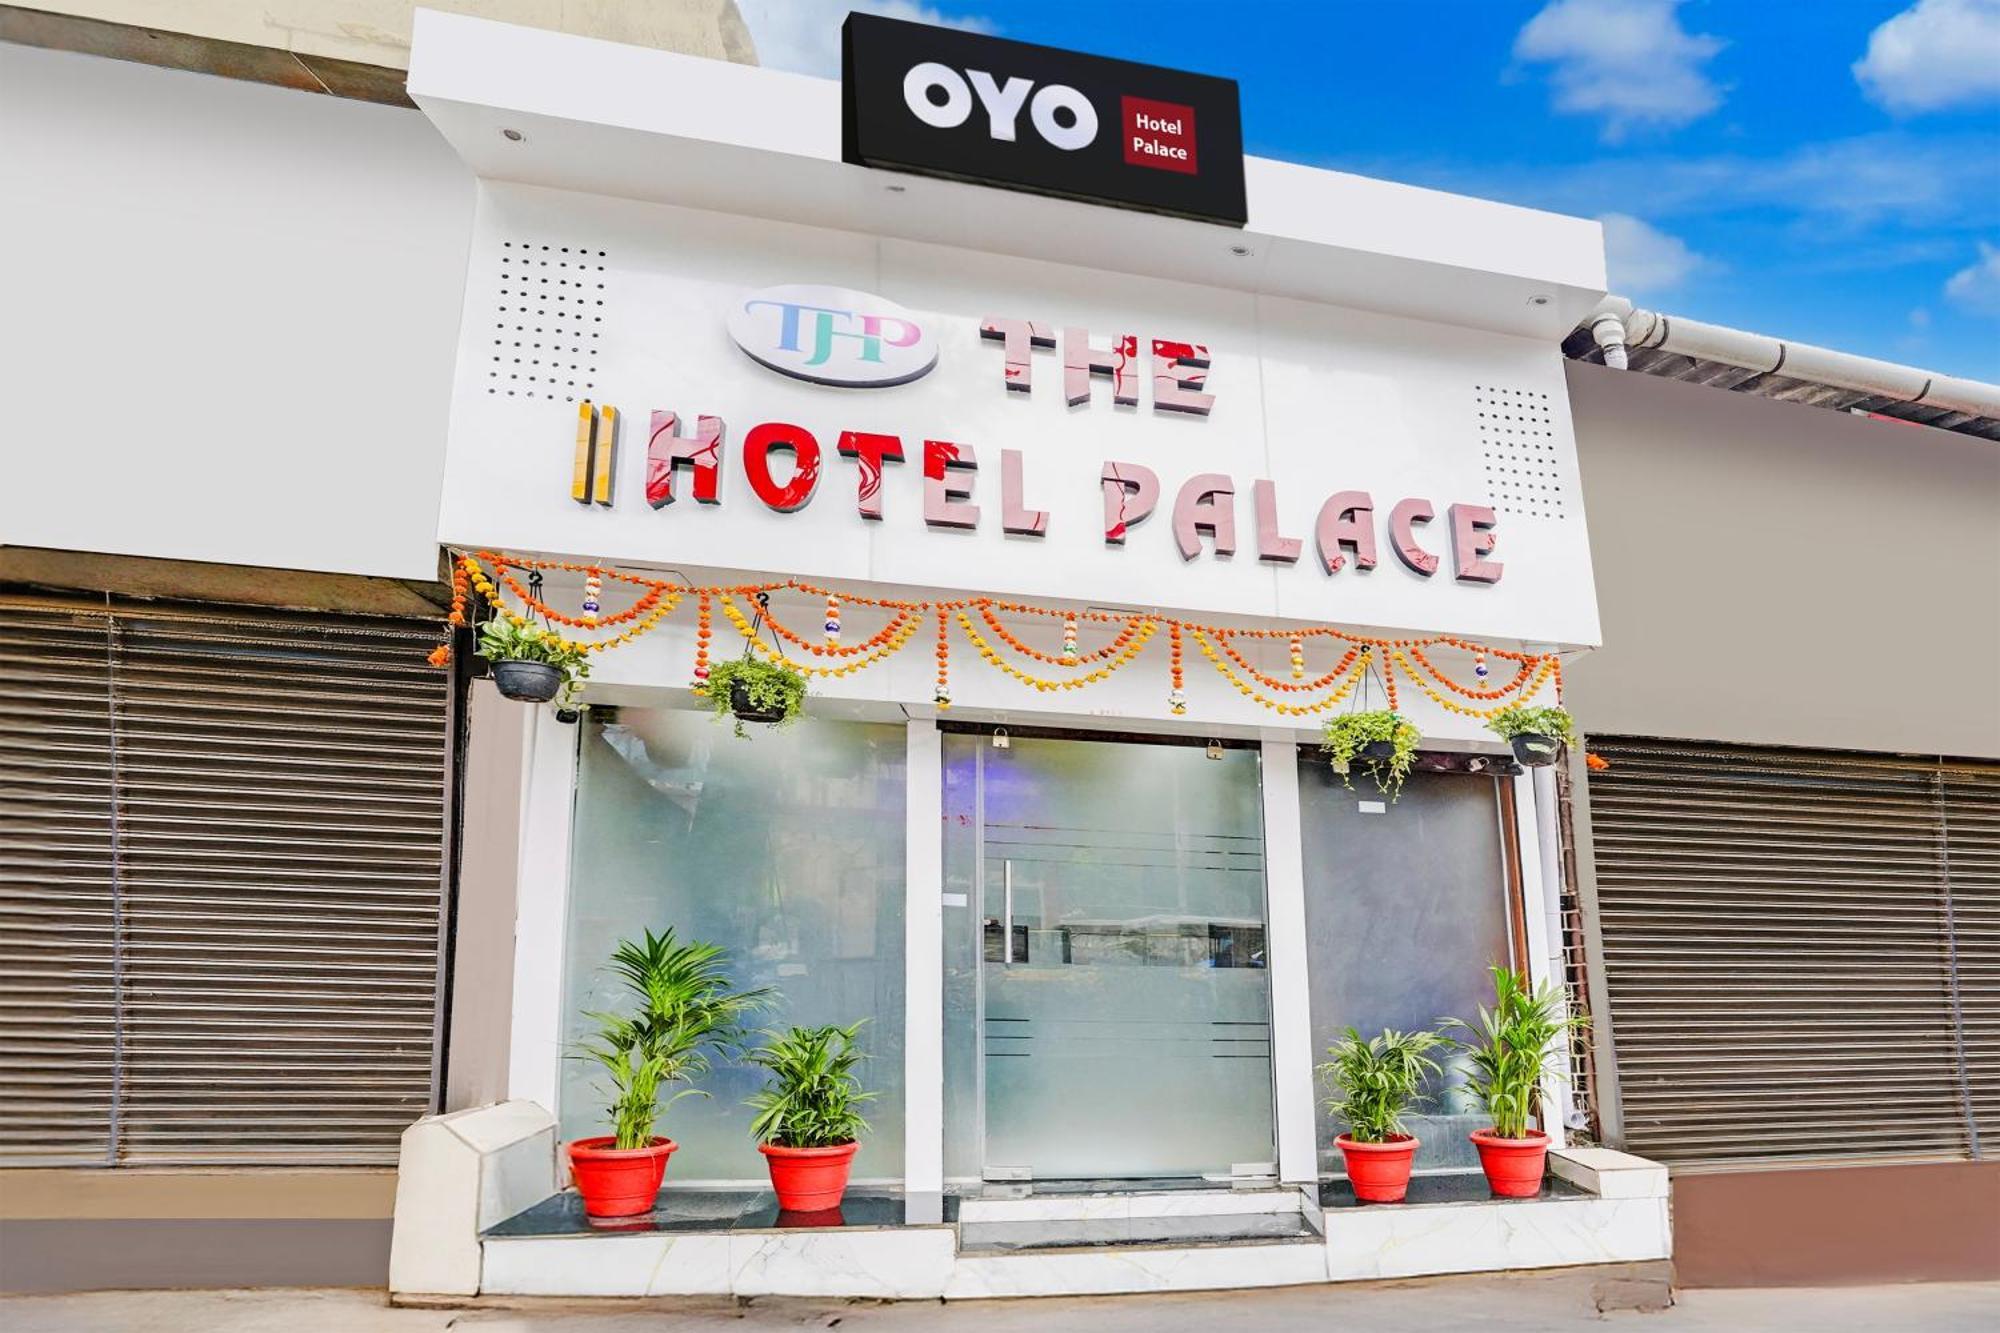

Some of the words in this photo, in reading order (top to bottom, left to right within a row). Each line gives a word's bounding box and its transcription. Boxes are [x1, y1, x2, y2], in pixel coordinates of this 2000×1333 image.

[903, 62, 1098, 150] OYO
[1133, 136, 1187, 160] Palace
[1136, 113, 1182, 135] Hotel
[980, 316, 1216, 416] THE
[646, 408, 1050, 537] HOTEL
[1101, 461, 1505, 583] PALACE
